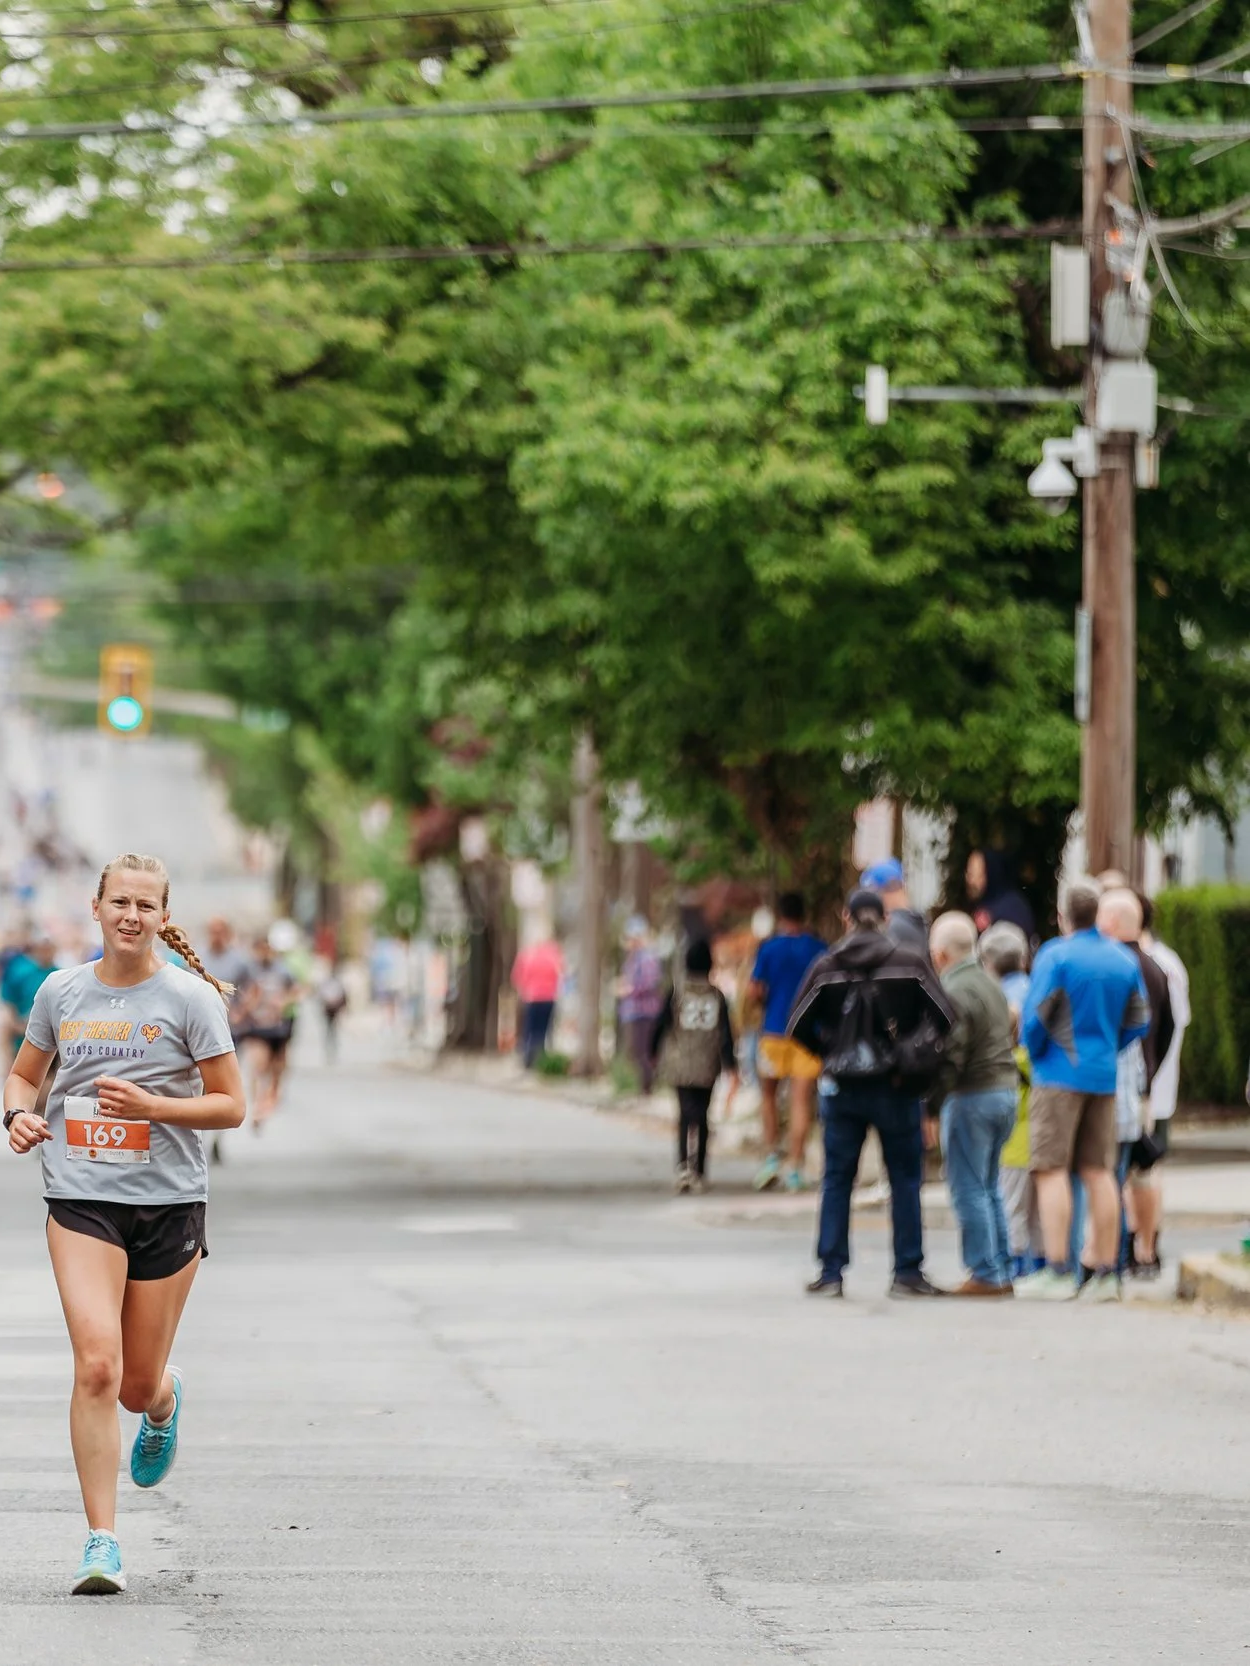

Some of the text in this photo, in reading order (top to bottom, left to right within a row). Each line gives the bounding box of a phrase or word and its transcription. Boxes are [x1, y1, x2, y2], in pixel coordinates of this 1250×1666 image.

[83, 1021, 133, 1041] CHESTER
[98, 1046, 145, 1058] COUNTRY
[83, 1123, 127, 1146] 169
